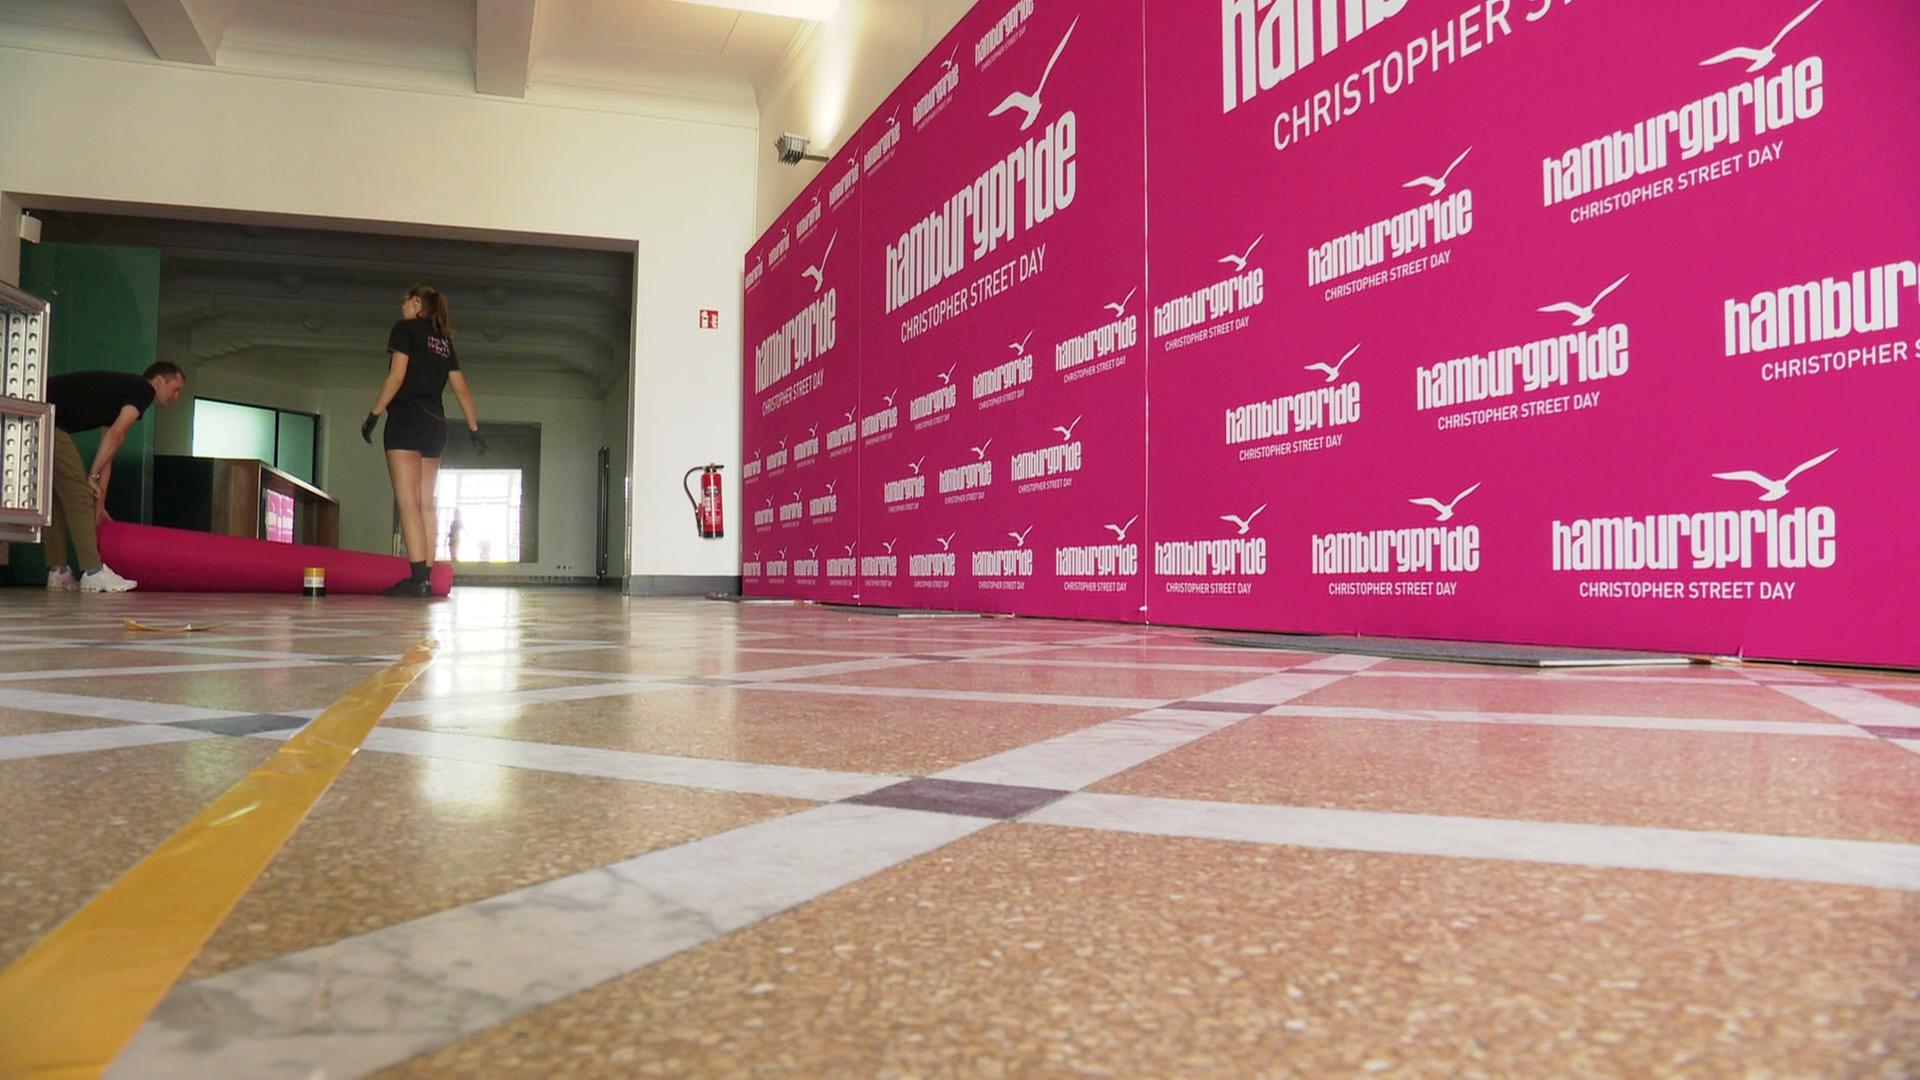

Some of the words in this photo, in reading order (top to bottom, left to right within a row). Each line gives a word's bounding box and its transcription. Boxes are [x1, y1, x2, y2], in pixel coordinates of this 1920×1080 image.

[1273, 0, 1512, 150] CHRISTOPHER
[1543, 56, 1823, 207] hamburgpride
[1570, 177, 1674, 224] CHRISTOPHER
[1677, 153, 1743, 190] STREET
[1748, 140, 1783, 168] DAY
[886, 111, 1076, 314] hamburgpride
[1308, 189, 1472, 286] hamburgpride
[901, 288, 968, 343] CHRISTOPHER
[970, 260, 1016, 307] STREET
[1020, 243, 1045, 282] DAY
[1325, 270, 1388, 301] CHRISTOPHER
[1390, 257, 1428, 281] STREET
[1430, 249, 1451, 268] DAY
[1154, 268, 1263, 338] hamburgpride
[1724, 260, 1920, 357] hambur
[756, 288, 836, 394] hamburgpride
[1056, 315, 1136, 371] hamburgpride
[1165, 329, 1208, 351] CHRISTOPHER
[1209, 320, 1234, 338] STREET
[1235, 316, 1249, 330] DAY
[973, 354, 1032, 399] hamburgpride
[1064, 365, 1096, 383] CHRISTOPHER
[1096, 359, 1115, 373] STREET
[1115, 356, 1126, 367] DAY
[1417, 323, 1629, 410] hamburgpride
[1761, 341, 1908, 381] CHRISTOPHER
[1226, 381, 1360, 444] hamburgpride
[1438, 405, 1518, 430] CHRISTOPHER
[1521, 396, 1570, 418] STREET
[1573, 391, 1600, 410] DAY
[1011, 441, 1081, 481] hamburgpride
[1239, 442, 1291, 461] CHRISTOPHER
[1292, 436, 1324, 453] STREET
[1326, 433, 1342, 448] DAY
[939, 460, 992, 493] hamburgpride
[1056, 543, 1137, 576] hamburgpride
[1155, 537, 1266, 575] hamburgpride
[1312, 525, 1479, 574] hamburgpride
[1552, 506, 1836, 570] hamburgpride
[972, 549, 1032, 576] hamburgpride
[1064, 582, 1096, 591] CHRISTOPHER
[1096, 582, 1115, 592] STREET
[1115, 582, 1127, 592] DAY
[1166, 582, 1209, 594] CHRISTOPHER
[1209, 582, 1236, 594] STREET
[1238, 583, 1252, 594] DAY
[1329, 582, 1393, 595] CHRISTOPHER
[1395, 582, 1434, 595] STREET
[1436, 582, 1457, 595] DAY
[1579, 581, 1685, 598] CHRISTOPHER
[1689, 581, 1755, 599] STREET
[1760, 581, 1796, 600] DAY
